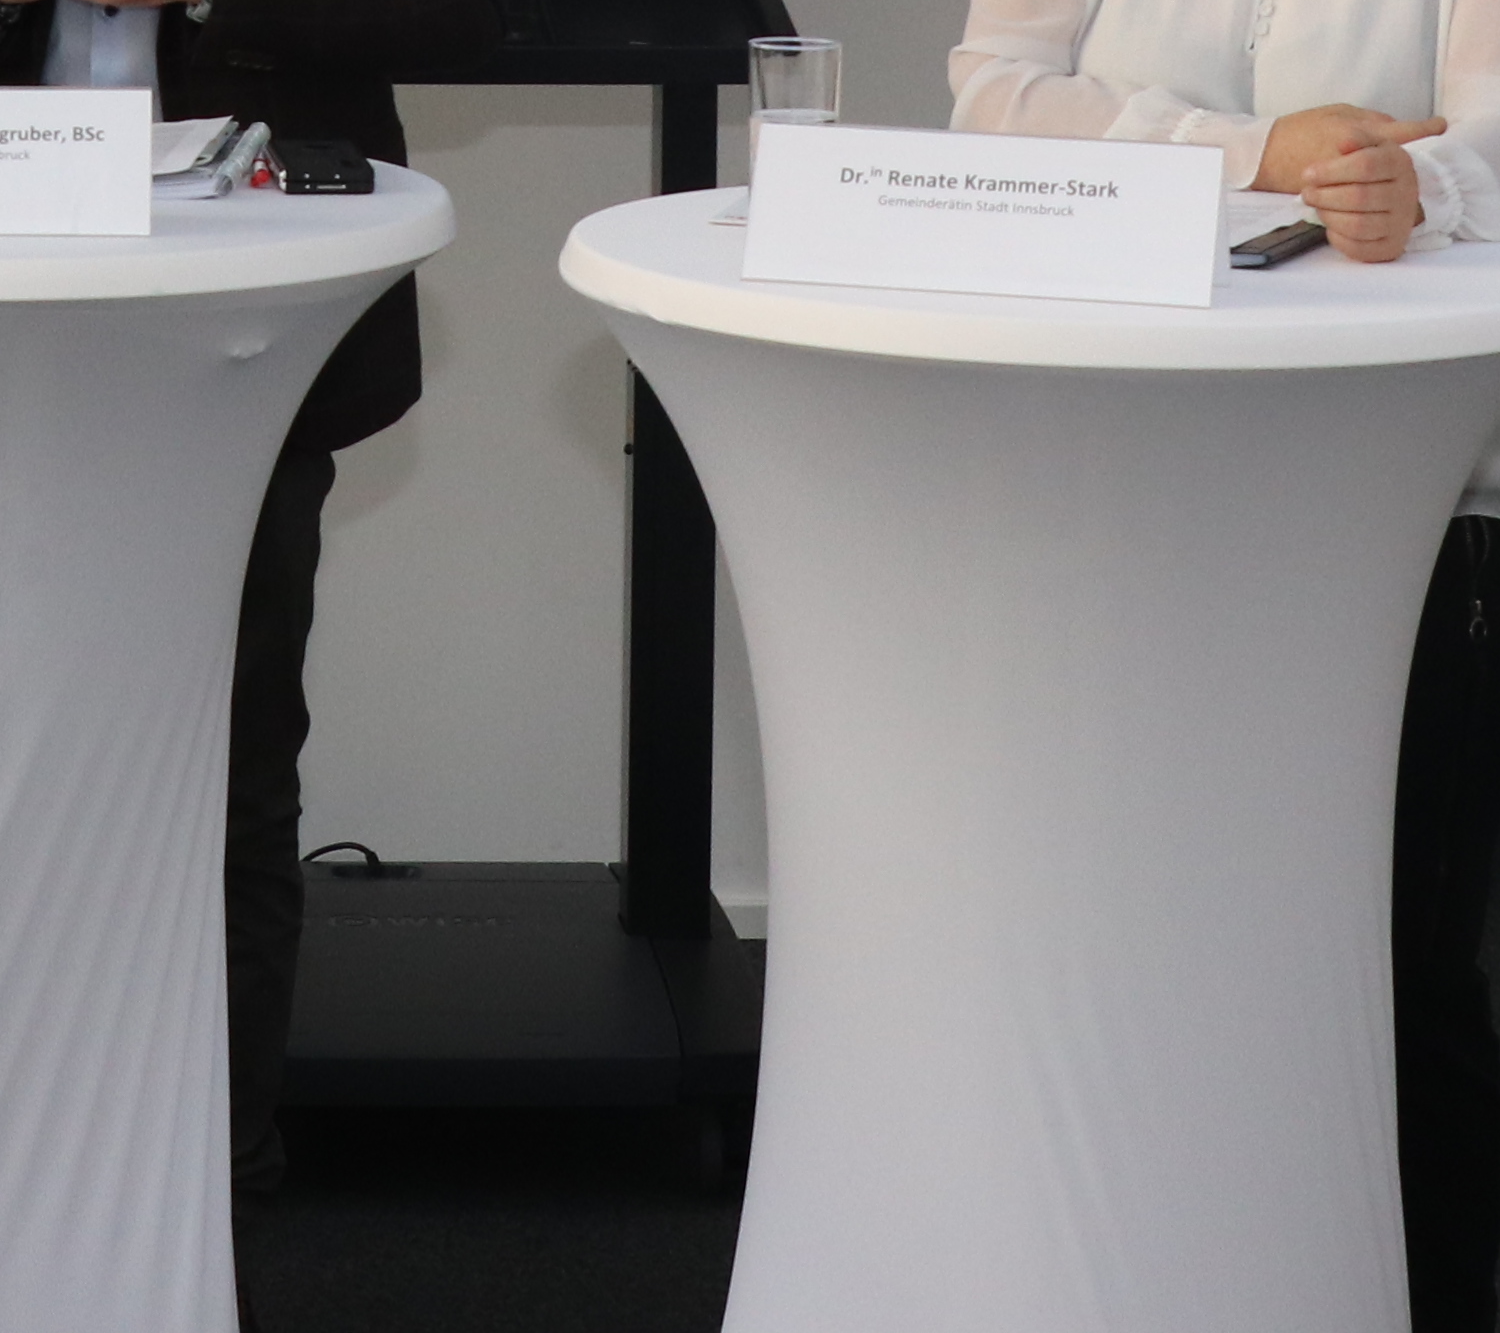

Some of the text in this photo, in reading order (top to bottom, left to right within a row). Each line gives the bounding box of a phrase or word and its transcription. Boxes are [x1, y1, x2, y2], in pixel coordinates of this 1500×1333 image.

[72, 126, 105, 142] BSc
[888, 170, 958, 190] Renate
[964, 173, 1119, 198] Krammer-Stark
[877, 194, 1075, 218] Gemeinderätin Stadt Innsbruck
